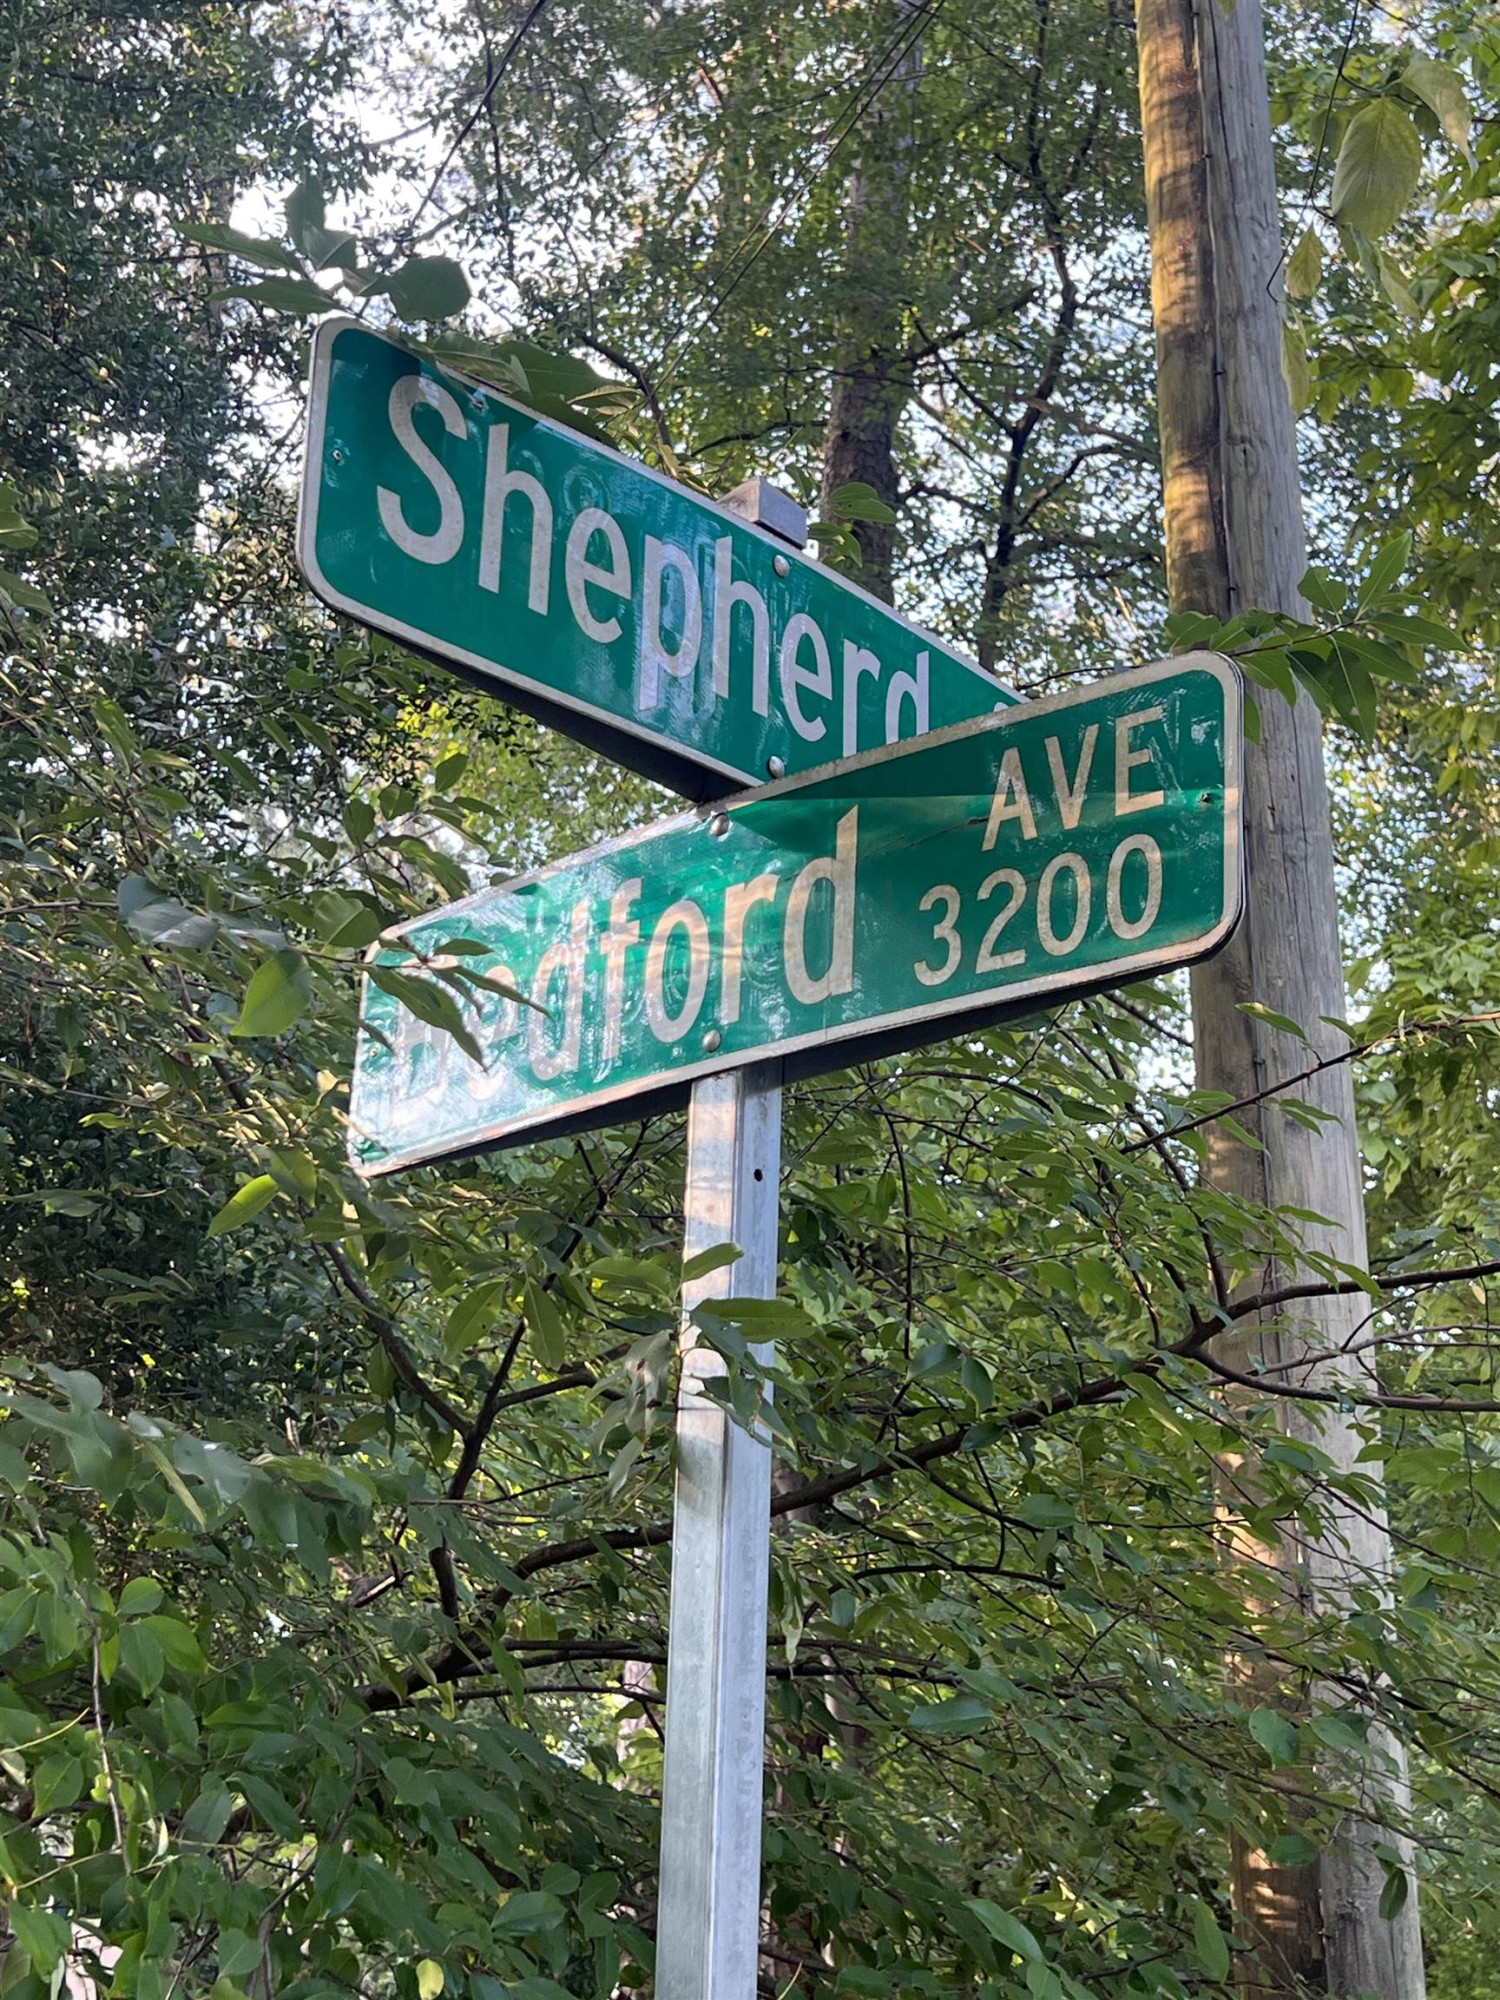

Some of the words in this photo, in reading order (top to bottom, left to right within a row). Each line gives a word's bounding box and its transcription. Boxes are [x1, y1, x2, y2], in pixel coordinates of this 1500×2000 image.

[376, 374, 931, 758] Shepherd
[980, 704, 1165, 852] AVE
[912, 833, 1164, 987] 3200
